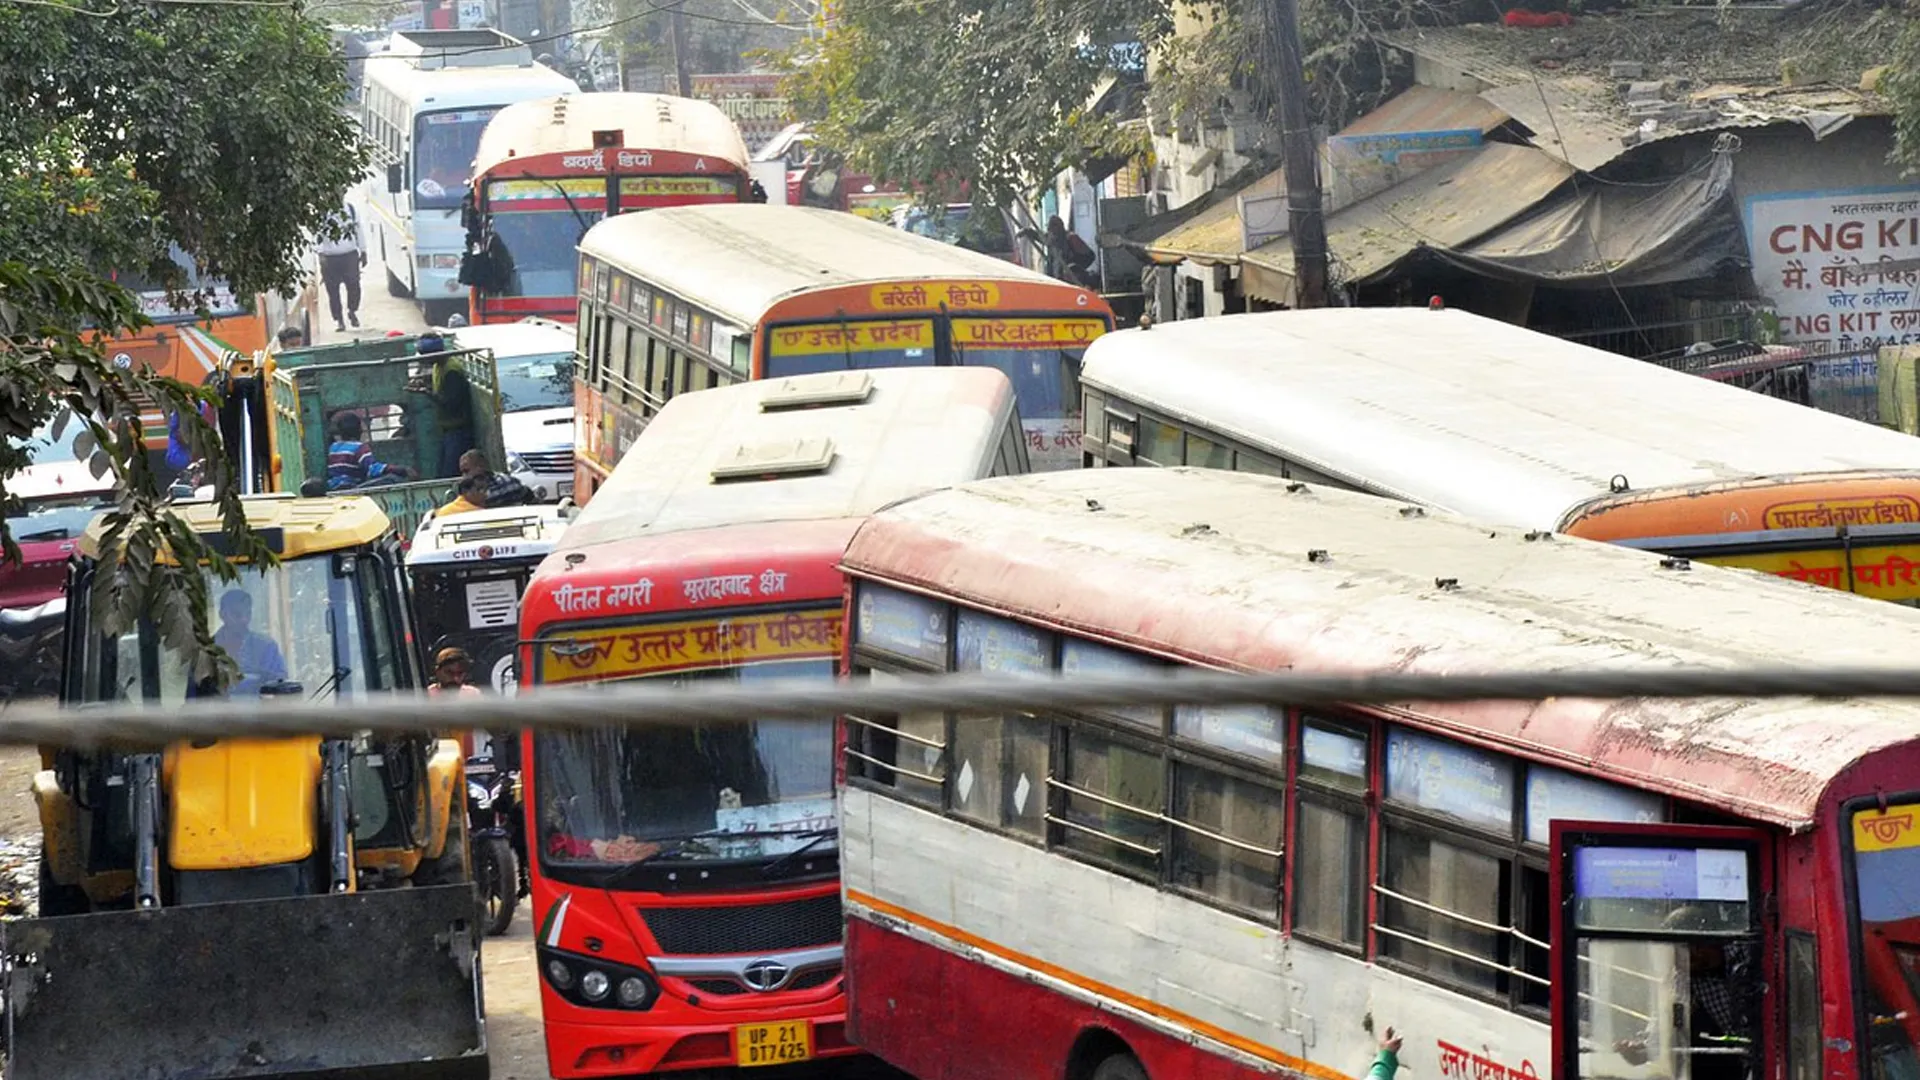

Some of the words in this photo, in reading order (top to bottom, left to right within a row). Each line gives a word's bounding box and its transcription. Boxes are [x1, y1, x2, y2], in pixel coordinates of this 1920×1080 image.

[617, 152, 653, 167] डिपो
[694, 158, 706, 170] A
[1769, 220, 1866, 255] CNG
[881, 286, 928, 306] बरेली
[946, 284, 990, 305] डिपो
[1827, 289, 1858, 309] फोर
[1839, 311, 1882, 333] KIT
[808, 326, 860, 348] उत्तर
[868, 319, 926, 344] प्रदेश
[452, 549, 478, 559] CITY
[495, 545, 518, 556] LIFE
[551, 583, 605, 613] पीतल
[606, 577, 655, 608] नगरी
[682, 574, 753, 604] मुरादाबाद
[759, 568, 787, 596] क्षेत्र
[618, 628, 691, 664] उत्तर
[690, 619, 761, 655] प्रदेश
[749, 1028, 768, 1044] UP
[778, 1025, 797, 1042] 21
[749, 1042, 806, 1063] DT7425
